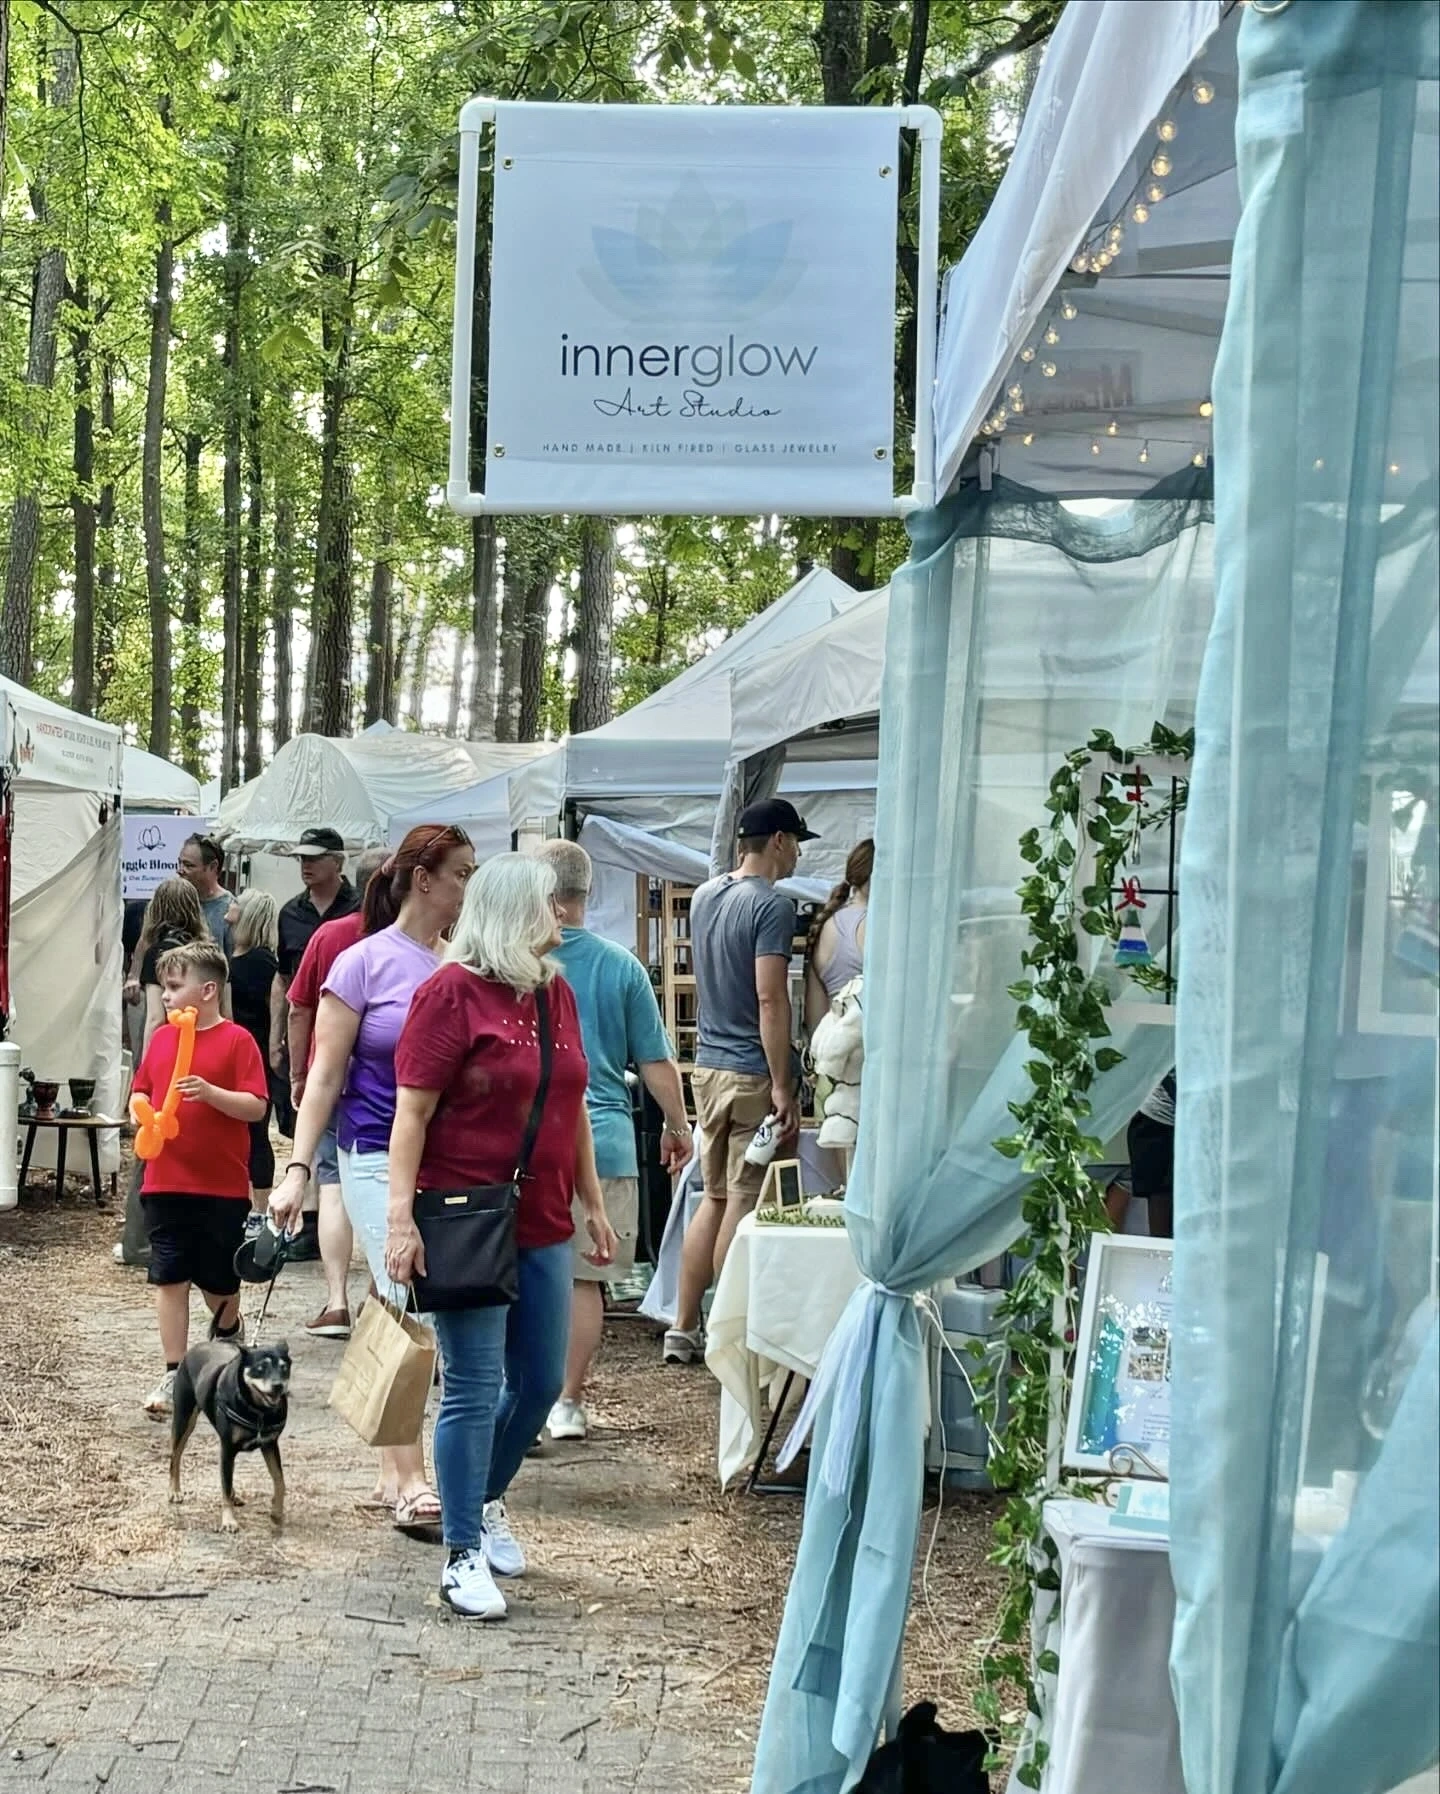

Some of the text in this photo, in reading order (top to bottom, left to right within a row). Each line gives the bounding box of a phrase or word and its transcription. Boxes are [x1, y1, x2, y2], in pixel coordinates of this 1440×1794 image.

[560, 333, 819, 388] innerglow
[593, 386, 783, 418] Art Studio
[542, 443, 578, 453] HAND
[585, 443, 622, 453] MADE
[642, 443, 671, 453] KILN
[677, 443, 714, 453] FIRED
[734, 443, 775, 453] GLASS
[782, 443, 838, 453] JEWELRY
